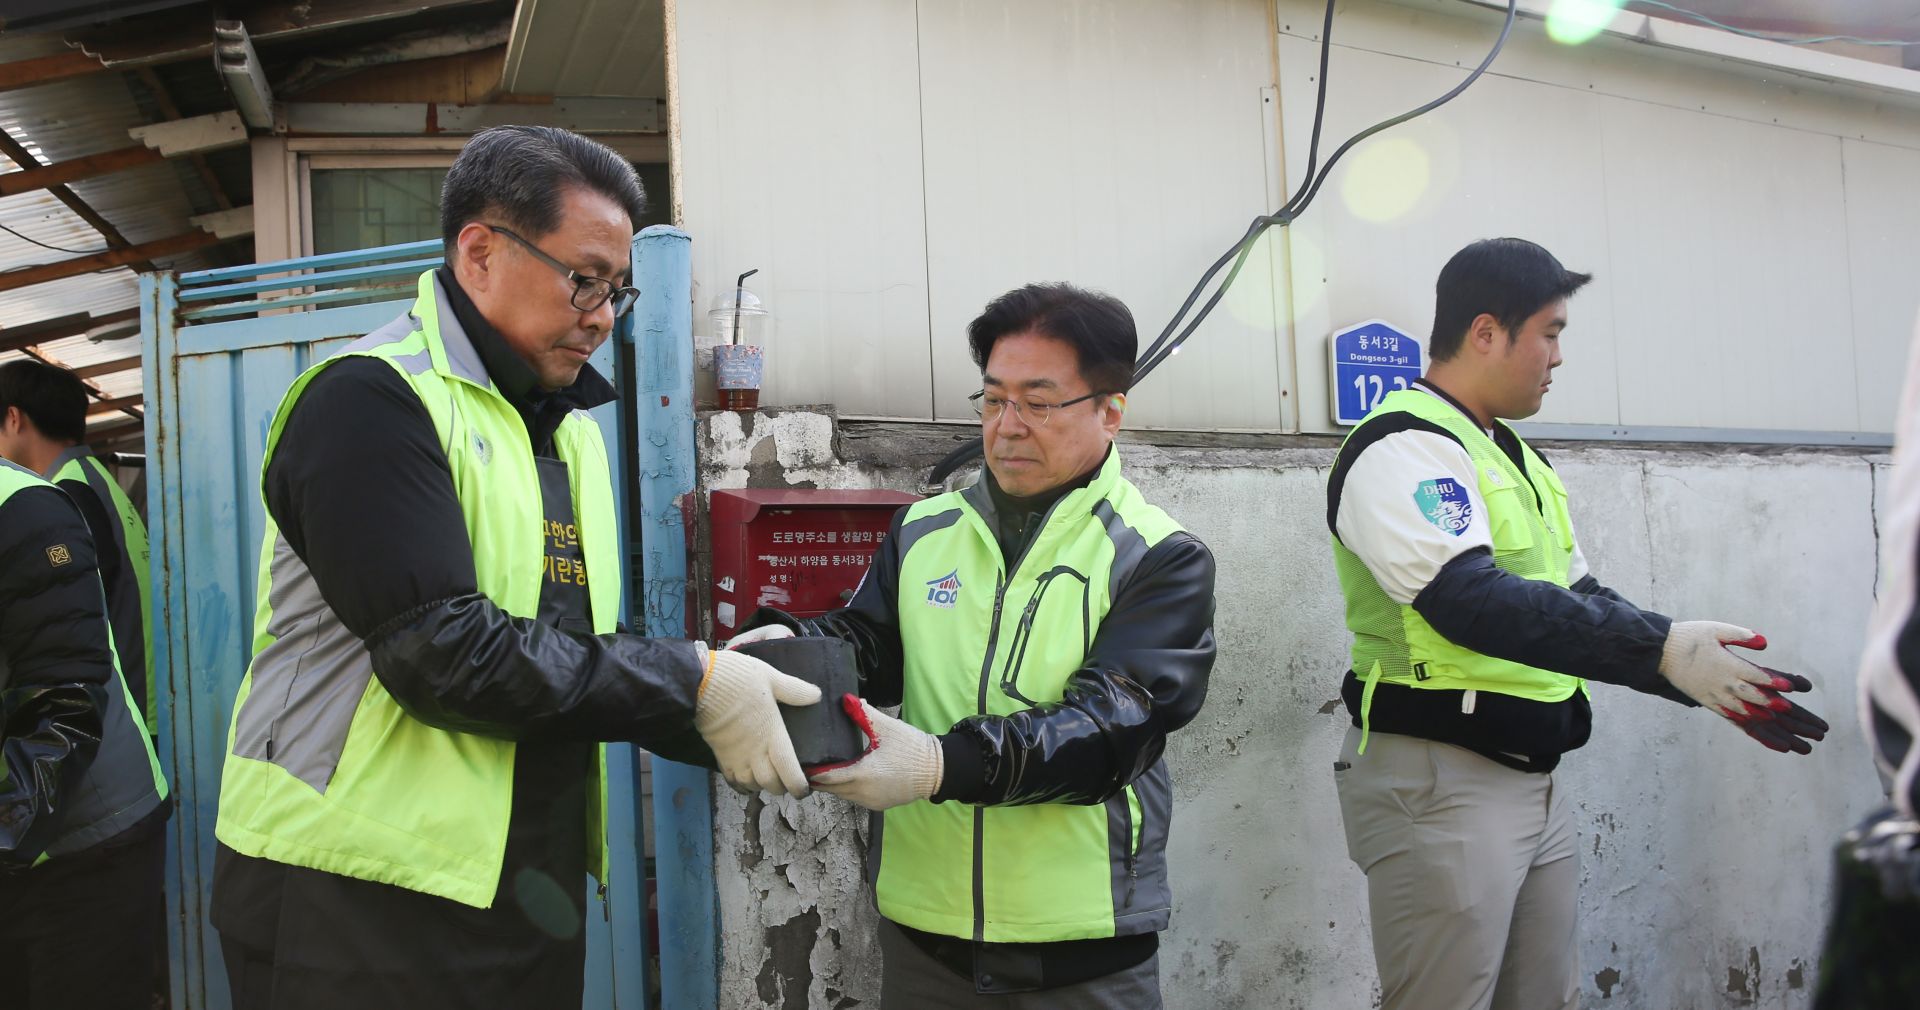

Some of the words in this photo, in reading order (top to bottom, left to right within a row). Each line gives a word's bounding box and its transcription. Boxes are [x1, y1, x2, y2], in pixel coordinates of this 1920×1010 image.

[1350, 353, 1387, 363] Dongseo
[1389, 355, 1409, 365] 3-gil
[1424, 482, 1454, 494] DHU
[772, 531, 837, 544] 도로명주소를
[841, 531, 873, 544] 생활화
[800, 555, 829, 567] 하양읍
[832, 555, 865, 566] 동서3길
